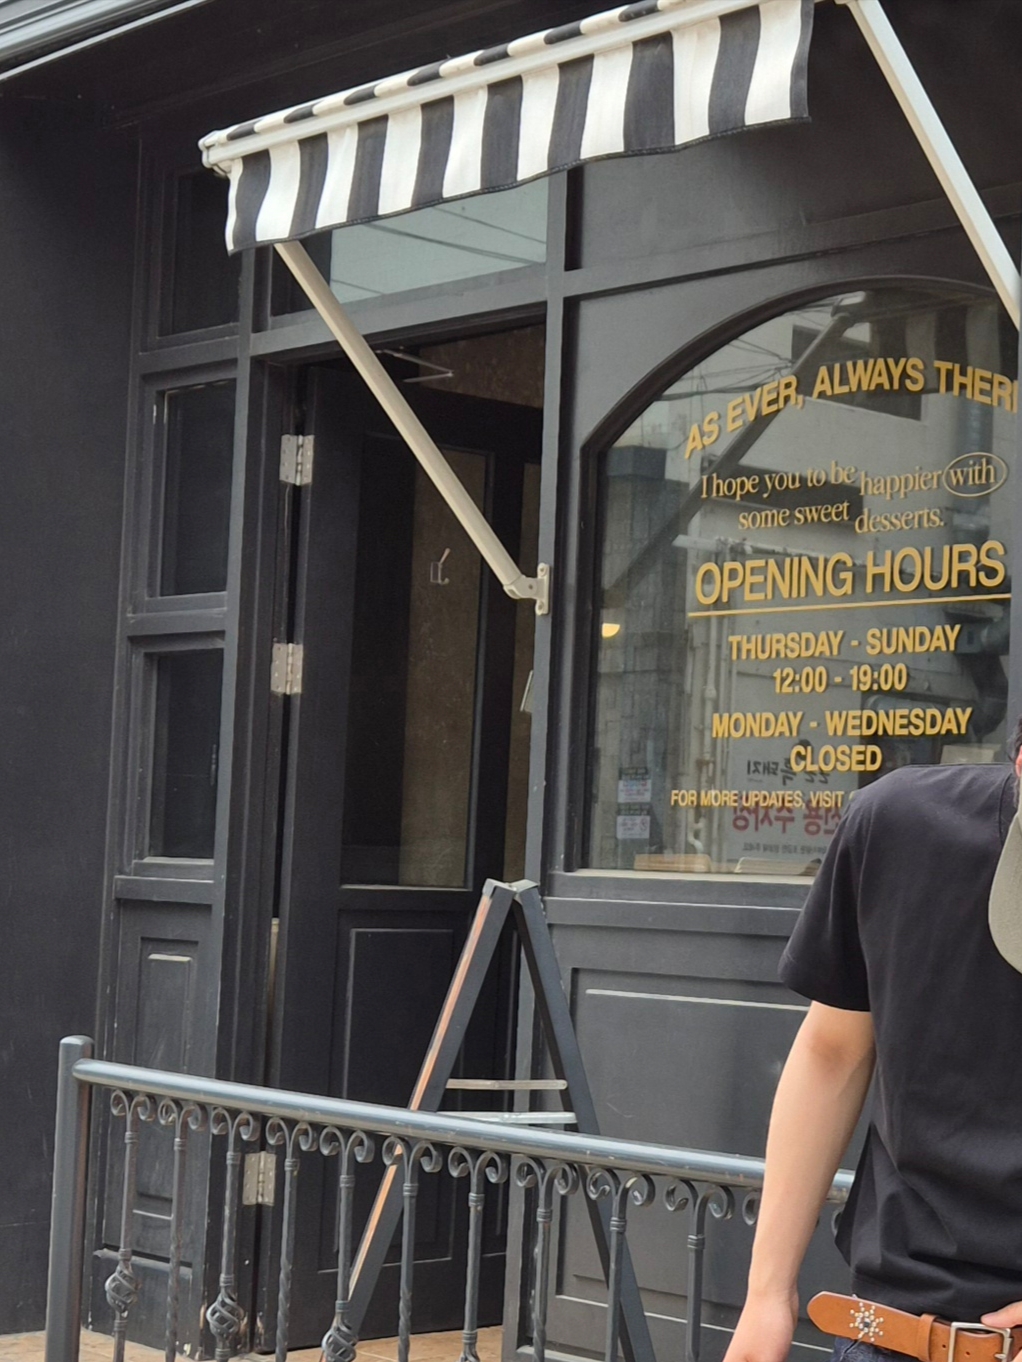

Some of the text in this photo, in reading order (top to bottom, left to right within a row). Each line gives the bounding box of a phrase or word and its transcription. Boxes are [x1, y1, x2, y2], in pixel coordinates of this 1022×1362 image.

[684, 411, 720, 459] AS
[727, 375, 805, 433] EVER,
[812, 357, 925, 399] ALWAYS
[700, 457, 996, 501] I hope you to be happier with
[739, 500, 945, 533] some sweet desserts.
[695, 540, 1006, 605] OPENING HOURS
[728, 630, 844, 660] THURSDAY
[866, 624, 961, 655] SUNDAY
[773, 665, 827, 694] 12:00
[850, 663, 908, 692] 19:00
[712, 711, 803, 739] MONDAY
[825, 707, 973, 736] WEDNESDAY
[789, 744, 883, 772] CLOSED
[671, 790, 698, 807] FOR
[700, 790, 739, 807] MORE
[742, 790, 806, 809] UPDATES,
[810, 790, 845, 808] VISIT
